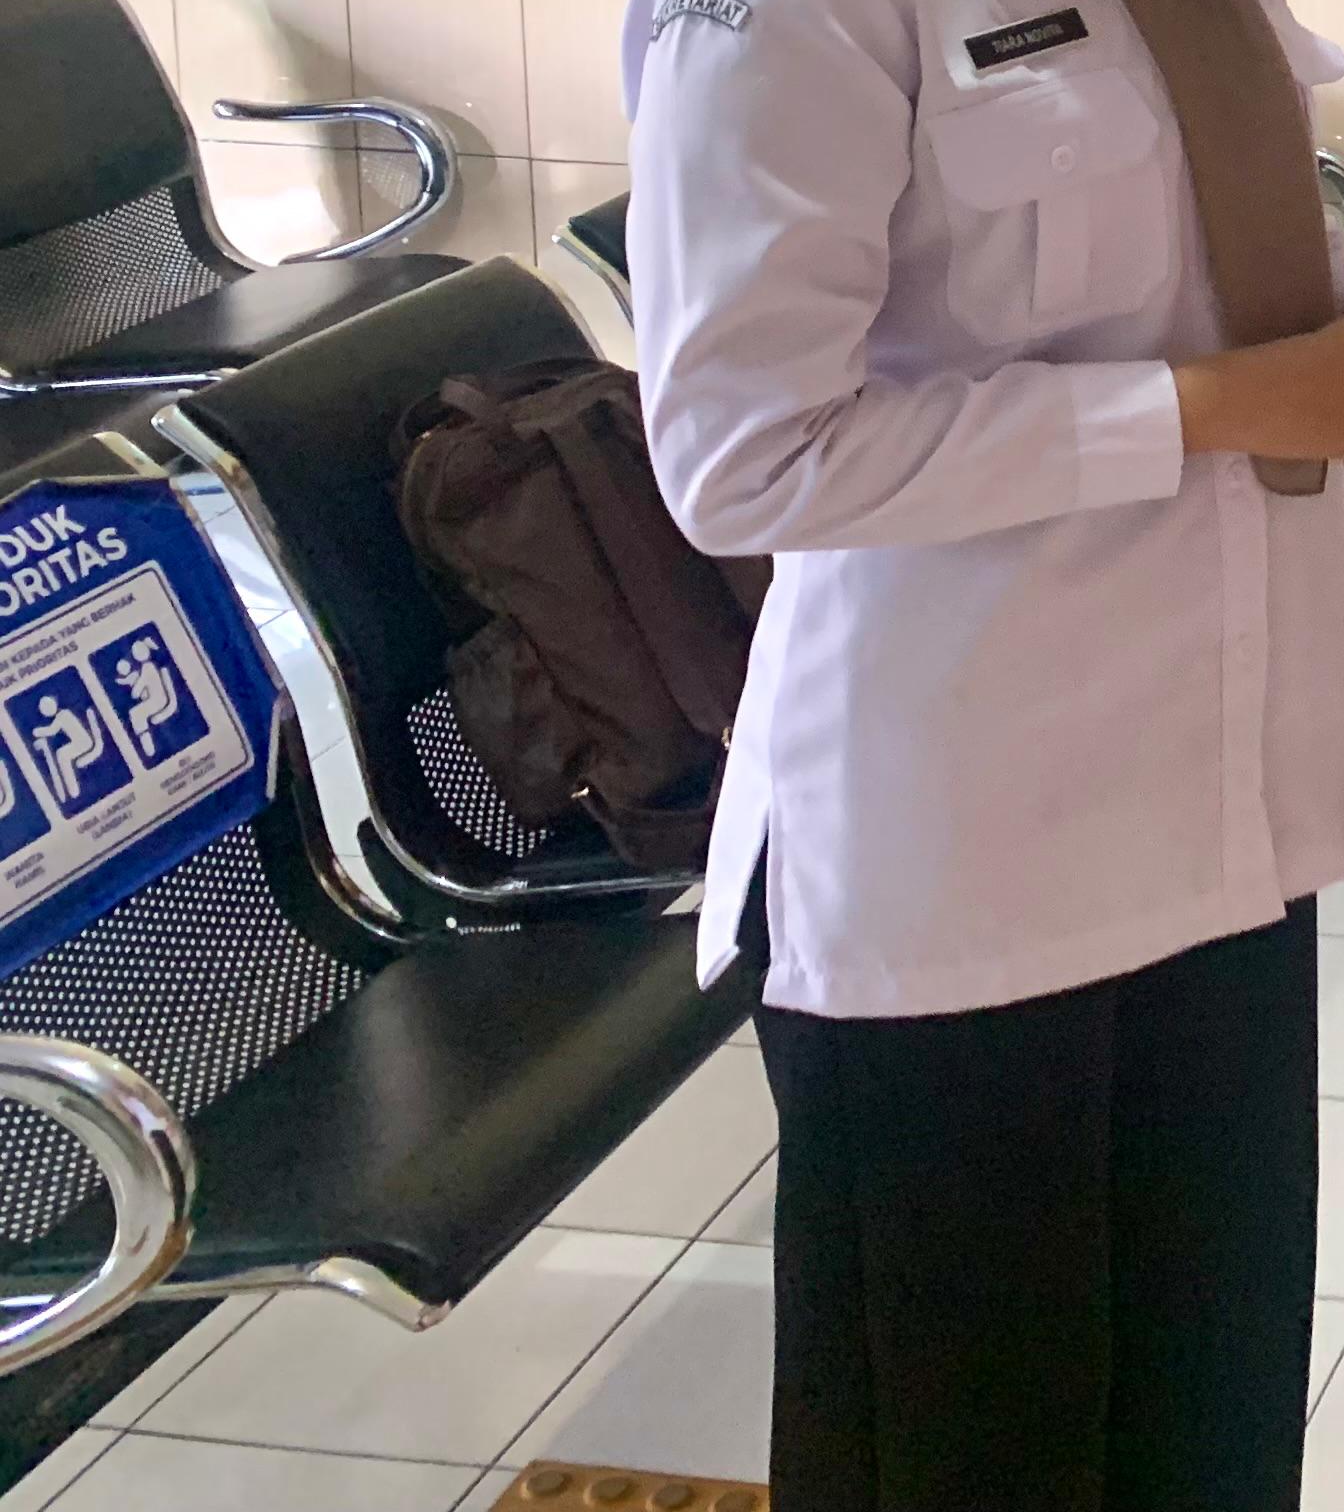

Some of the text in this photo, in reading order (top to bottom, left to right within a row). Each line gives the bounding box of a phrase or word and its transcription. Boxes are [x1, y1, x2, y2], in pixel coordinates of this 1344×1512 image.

[11, 593, 136, 664] KEPADA YANG BERHAK
[18, 641, 79, 679] PRIORITAS
